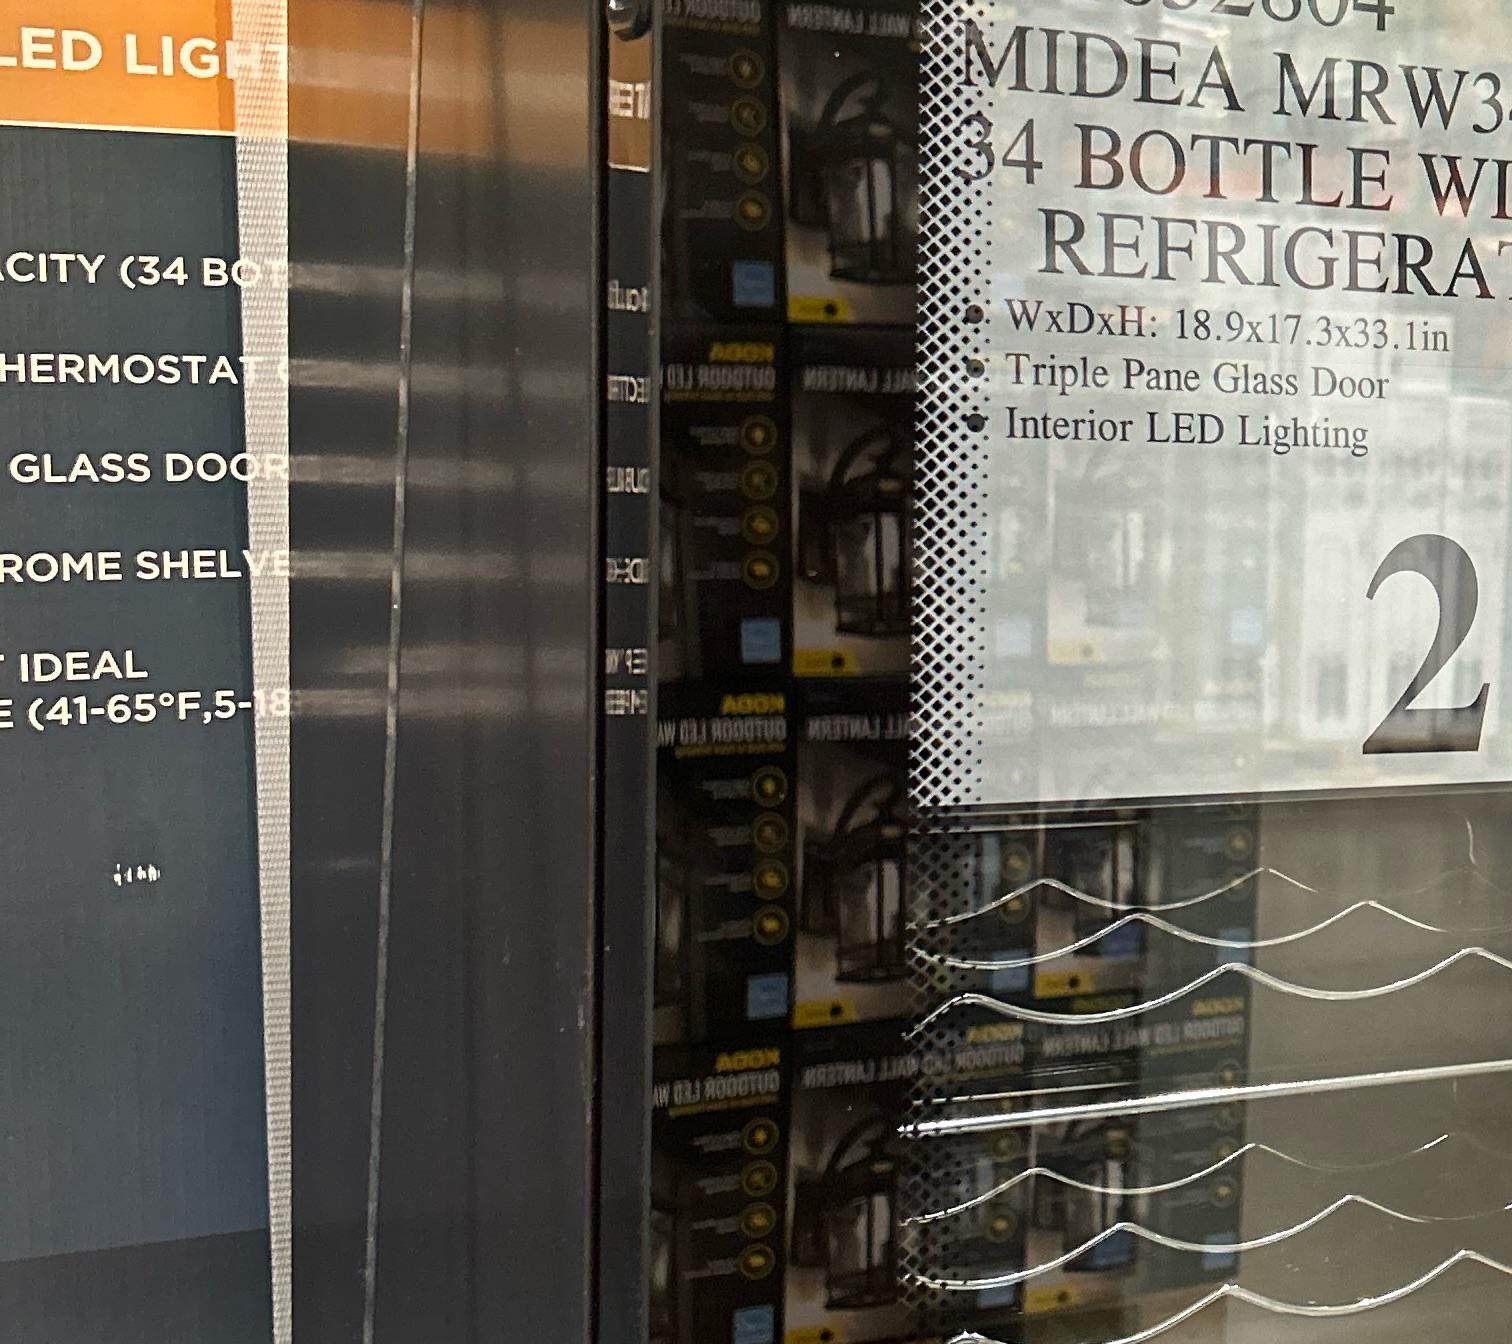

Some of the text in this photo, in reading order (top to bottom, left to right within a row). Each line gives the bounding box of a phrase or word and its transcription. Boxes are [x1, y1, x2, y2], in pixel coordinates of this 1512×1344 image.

[957, 18, 1246, 113] MIDEA
[956, 112, 1044, 186] 34
[1074, 122, 1394, 212] BOTTLE
[119, 255, 189, 291] (34
[1003, 298, 1451, 353] WxDxH: 18.9x17.3x33.1in
[1005, 353, 1390, 401] Triple Pane Glass Door
[1005, 406, 1370, 458] Interior LED Lighting
[8, 452, 152, 485] GLASS
[19, 649, 149, 683] IDEAL
